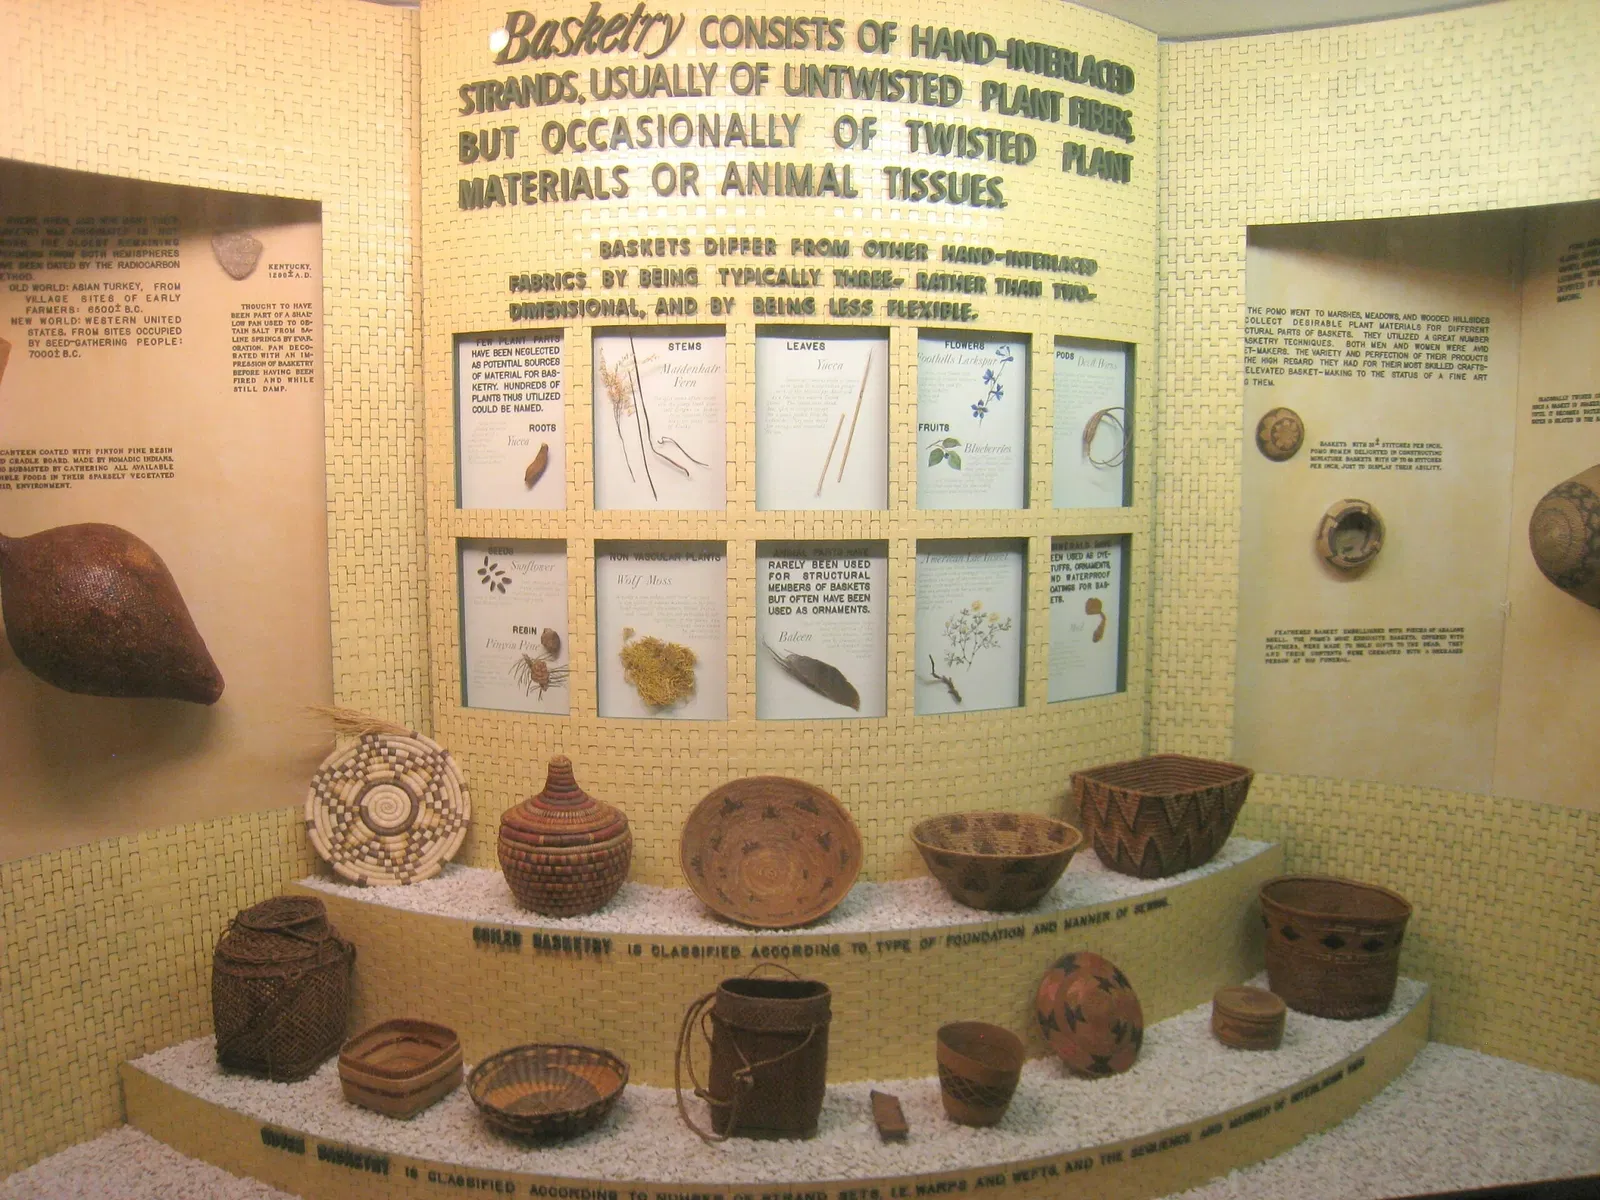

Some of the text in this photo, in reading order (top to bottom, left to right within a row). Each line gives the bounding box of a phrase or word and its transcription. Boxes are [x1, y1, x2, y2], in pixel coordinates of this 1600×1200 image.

[493, 1, 1136, 95] Basketry CONSISTS OF HAND-INTERLACED
[458, 61, 1136, 144] STRANDS, USUALLY OF UNTWISTED PLANT FIBERS,
[458, 112, 1134, 184] BUT OCCASIONALLY OF TWISTED PLANT
[458, 161, 1008, 210] MATERIALS OR ANIMAL TISSUES.
[113, 250, 180, 258] HEMISPHERES
[600, 237, 691, 260] BASKETS
[704, 236, 777, 257] DIFFER
[791, 238, 850, 257] FROM
[863, 239, 929, 261] OTHER
[117, 261, 181, 269] RADIOCARBON
[9, 282, 181, 292] OLD WORLD: ASIAN TURKEY, FROM
[509, 271, 587, 293] FABRICS
[602, 269, 627, 288] BY
[639, 267, 699, 288] BEING
[718, 267, 821, 288] TYPICALLY
[833, 269, 905, 289] THREE-
[916, 271, 987, 296] RATHER
[995, 277, 1043, 298] THAN
[26, 293, 182, 304] VILLAGE SITES OF EARLY
[26, 305, 144, 315] FARMERS: B.C.
[509, 296, 979, 322] DIMENSIONAL, AND BY BEING LESS FLEXIBLE.
[11, 315, 182, 326] NEW WORLD: WESTERN UNITED
[1247, 306, 1263, 316] THE
[1266, 307, 1287, 317] POMO
[1290, 308, 1311, 317] WENT
[1403, 312, 1418, 322] AND
[1421, 313, 1450, 323] WOODED
[1452, 314, 1491, 325] HILLSIDES
[71, 326, 183, 337] FROM SITES OCCUPIED
[1292, 318, 1490, 334] DESIRABLE PLANT MATERIALS FOR DIFFERENT
[28, 337, 183, 348] BY SEED-GATHERING PEOPLE:
[498, 334, 562, 346] PLANT PARTS
[944, 340, 985, 351] FLOWERS
[668, 342, 702, 351] STEMS
[786, 341, 826, 351] LEAVES
[471, 346, 561, 358] HAVE BEEN NEGLECTED
[1056, 350, 1075, 361] PODS
[471, 357, 561, 369] AS POTENTIAL SOURCES
[816, 358, 845, 371] Yucca
[472, 368, 561, 380] OF MATERIAL FOR BAS-
[1288, 367, 1353, 378] BASKET-MAKING
[233, 376, 315, 385] FIRED WHILE
[472, 380, 561, 392] KETRY. HUNDREDS OF
[673, 376, 698, 389] Fern
[472, 391, 561, 403] PLANTS THUS UTILIZED
[472, 403, 544, 414] COULD BE NAMED.
[528, 423, 557, 432] ROOTS
[918, 423, 950, 433] FRUITS
[507, 434, 531, 447] Yucca
[39, 448, 70, 456] COATED
[963, 442, 1013, 454] Blueberries
[129, 472, 175, 480] VEGETATED
[609, 551, 722, 562] NON VASCULAR PLANTS
[1066, 552, 1084, 561] USED
[510, 559, 556, 575] Sunflower
[768, 559, 872, 570] RARELY BEEN USED
[616, 573, 673, 589] Wolf Moss
[768, 571, 871, 581] FOR STRUCTURAL
[1066, 571, 1111, 582] WATERPROOF
[768, 582, 871, 592] MEMBERS OF BASKETS
[768, 593, 871, 604] BUT OFTEN HAVE BEEN
[768, 605, 871, 616] USED AS ORNAMENTS.
[512, 625, 538, 636] RESIN
[778, 630, 814, 643] Baleen
[651, 943, 742, 959] CLASSIFIED
[751, 942, 841, 960] ACCORDING
[876, 938, 912, 954] TYPE
[919, 935, 938, 951] OF
[946, 923, 1026, 948] FOUNDATION
[1033, 920, 1058, 937] AND
[427, 1170, 516, 1195] CLASSIFIED
[974, 1171, 1007, 1191] AND
